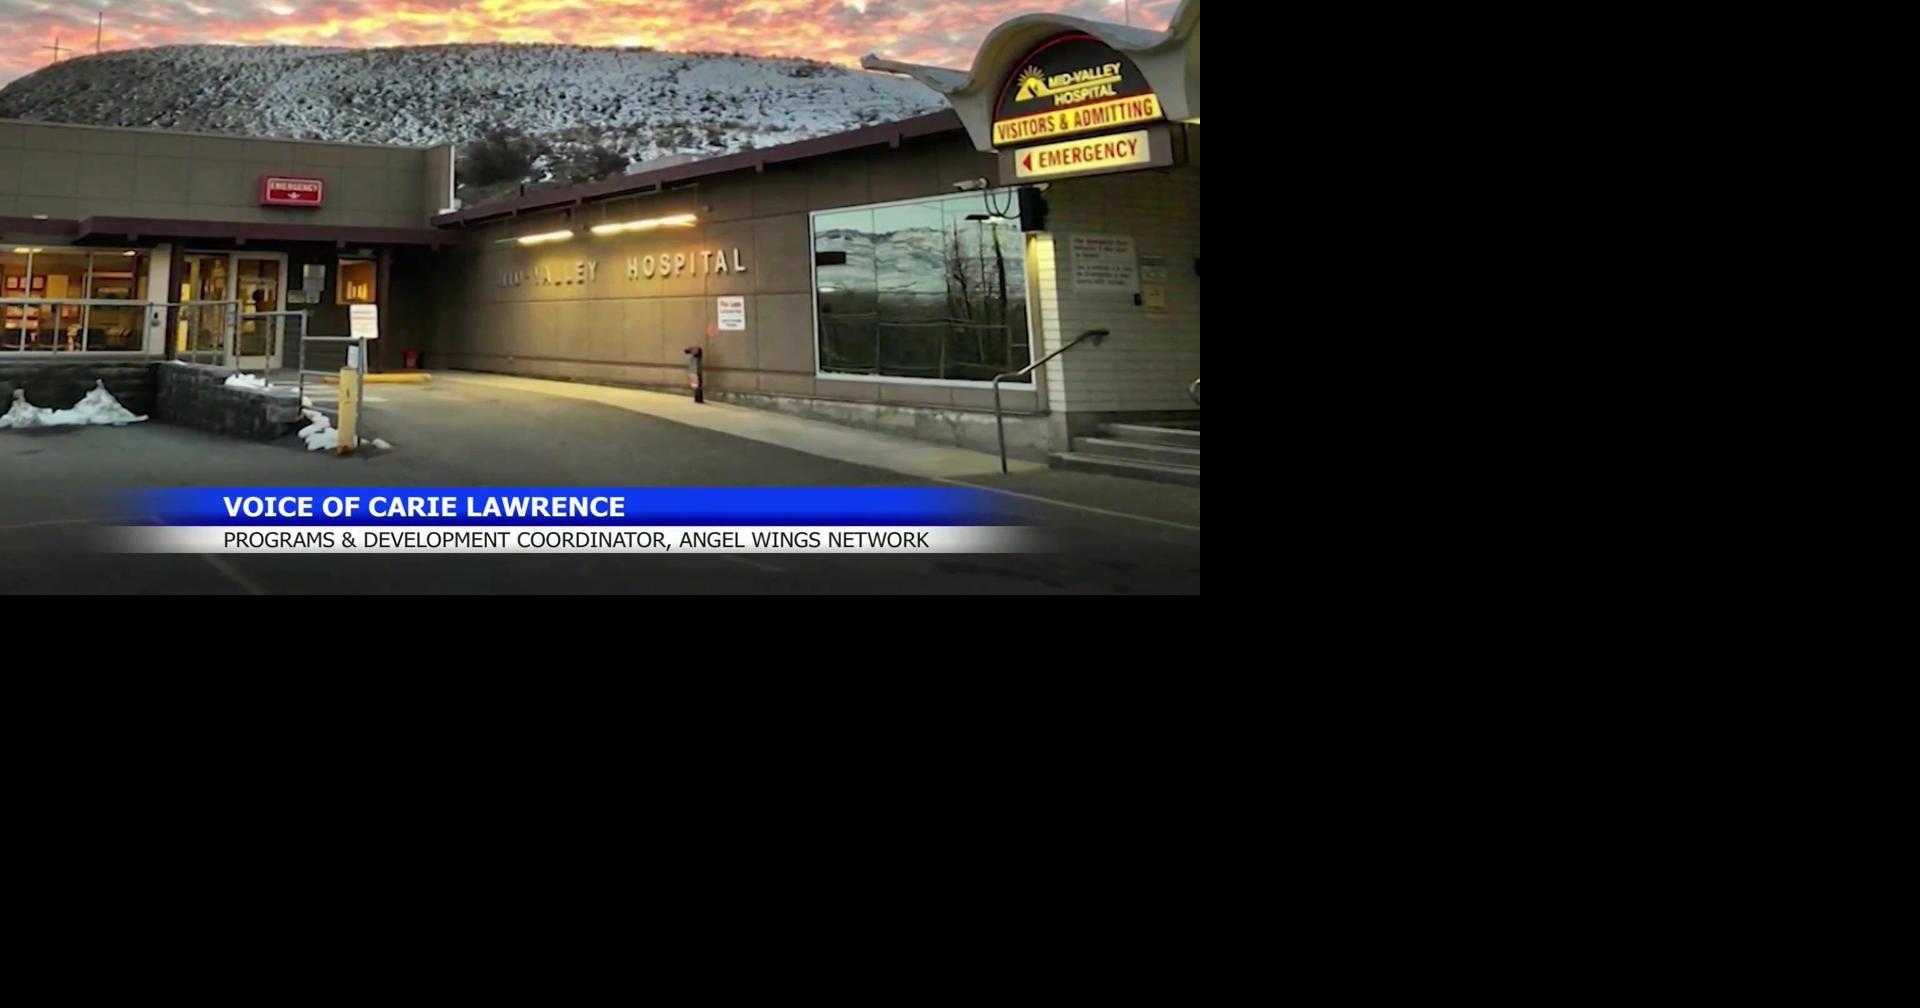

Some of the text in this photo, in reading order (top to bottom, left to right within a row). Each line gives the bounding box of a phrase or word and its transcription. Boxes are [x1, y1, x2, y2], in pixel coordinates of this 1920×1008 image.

[1048, 62, 1122, 88] MID-VALLEY
[1054, 85, 1118, 106] HOSPITAL
[997, 98, 1153, 141] VISITORS & ADMITTING
[1039, 138, 1138, 169] EMERGENCY
[270, 182, 318, 191] EMERGENCY
[628, 248, 747, 282] HOSPITAL
